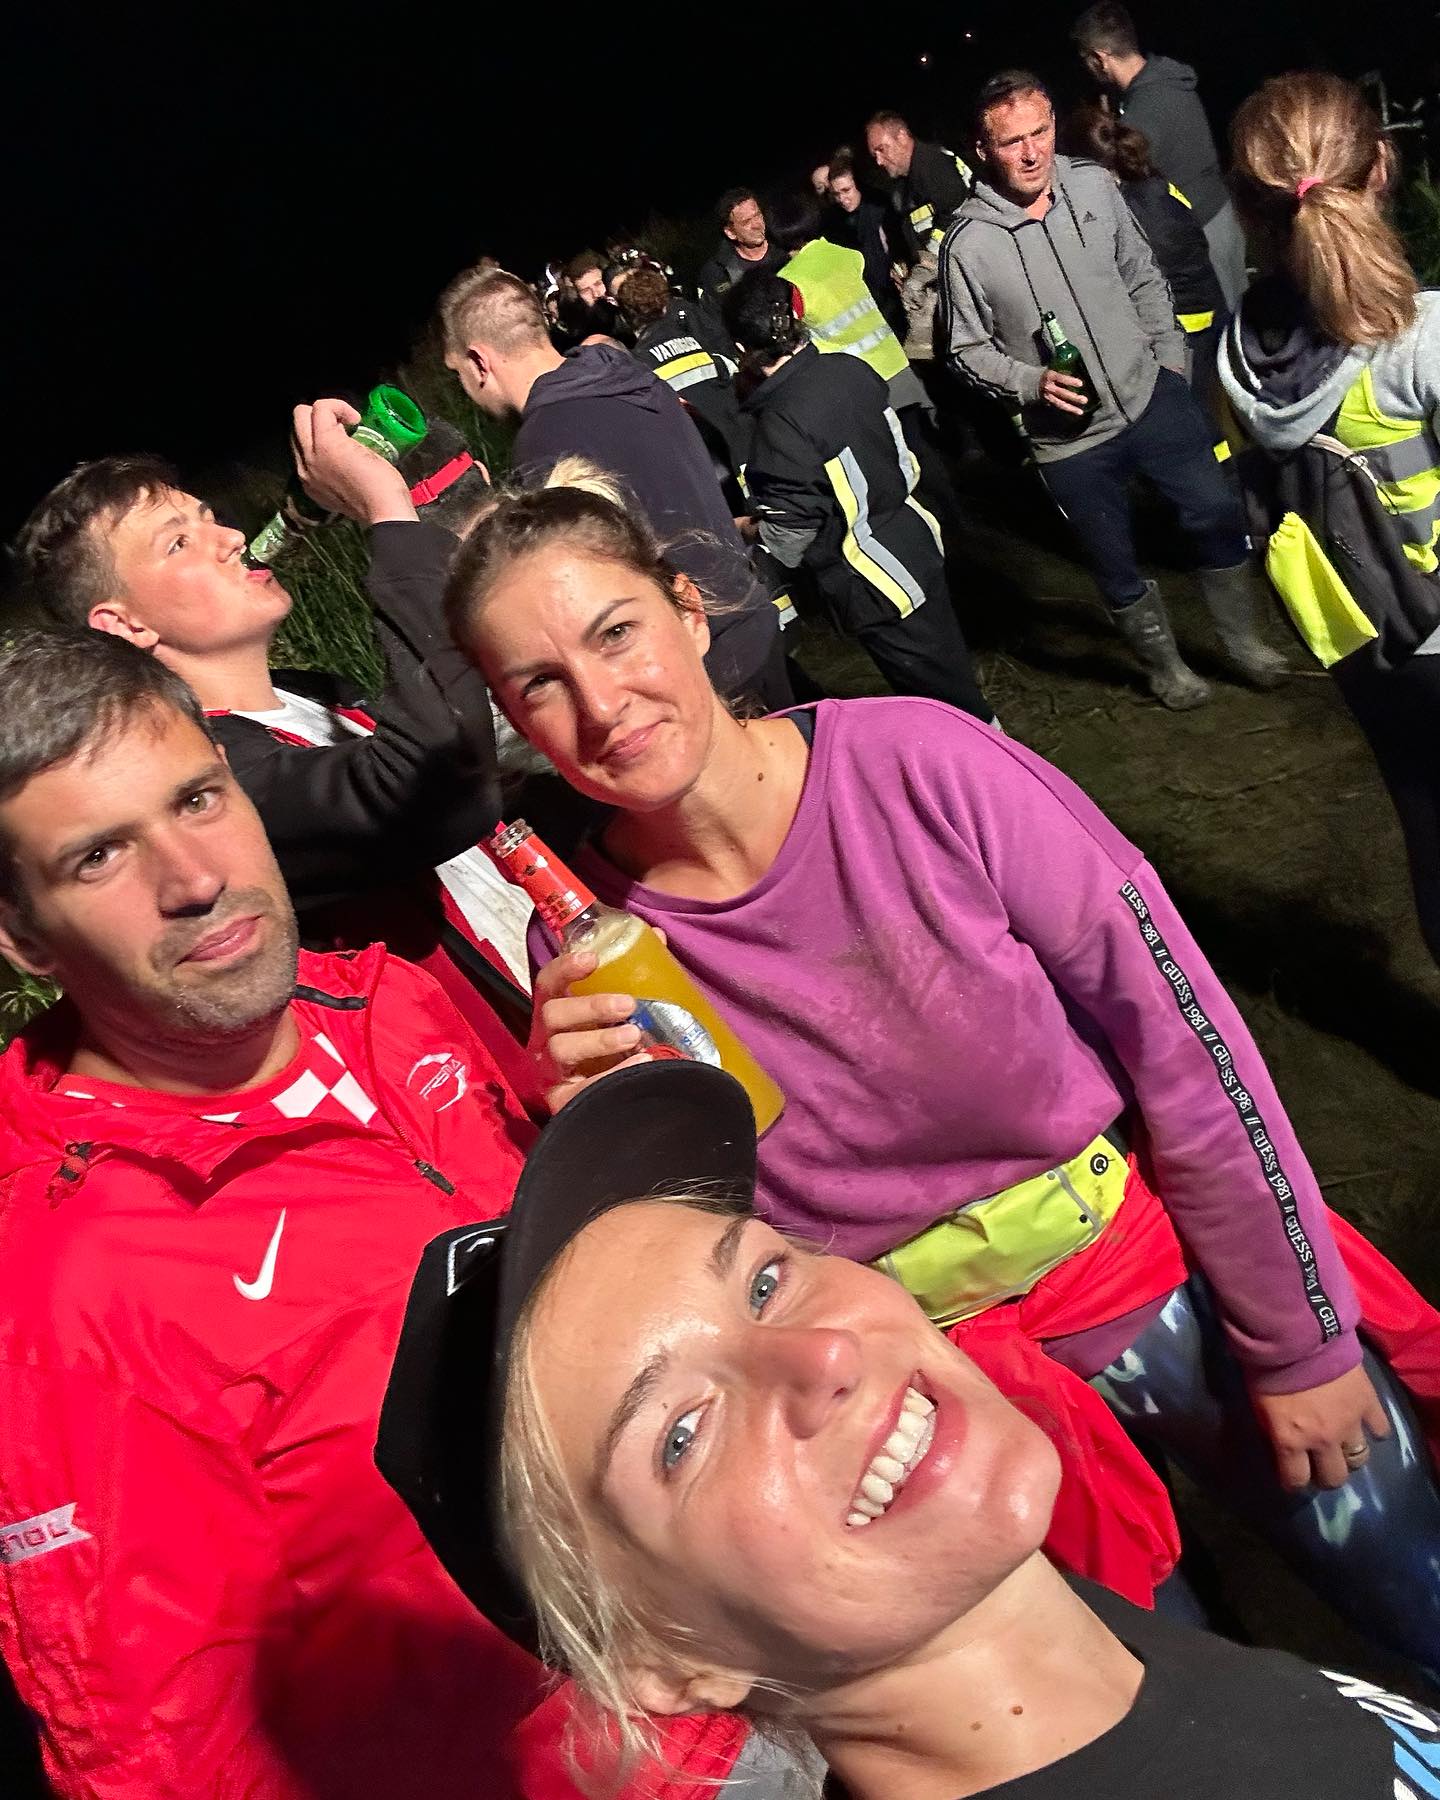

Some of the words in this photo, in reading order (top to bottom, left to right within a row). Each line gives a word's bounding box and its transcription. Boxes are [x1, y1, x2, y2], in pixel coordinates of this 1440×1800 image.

[1141, 918, 1161, 946] 981
[1162, 960, 1193, 1004] GUESS
[1183, 1003, 1209, 1031] 1981
[1252, 1128, 1278, 1172] GUESS
[1268, 1172, 1292, 1201] 1981
[1285, 1215, 1313, 1263] GUESS
